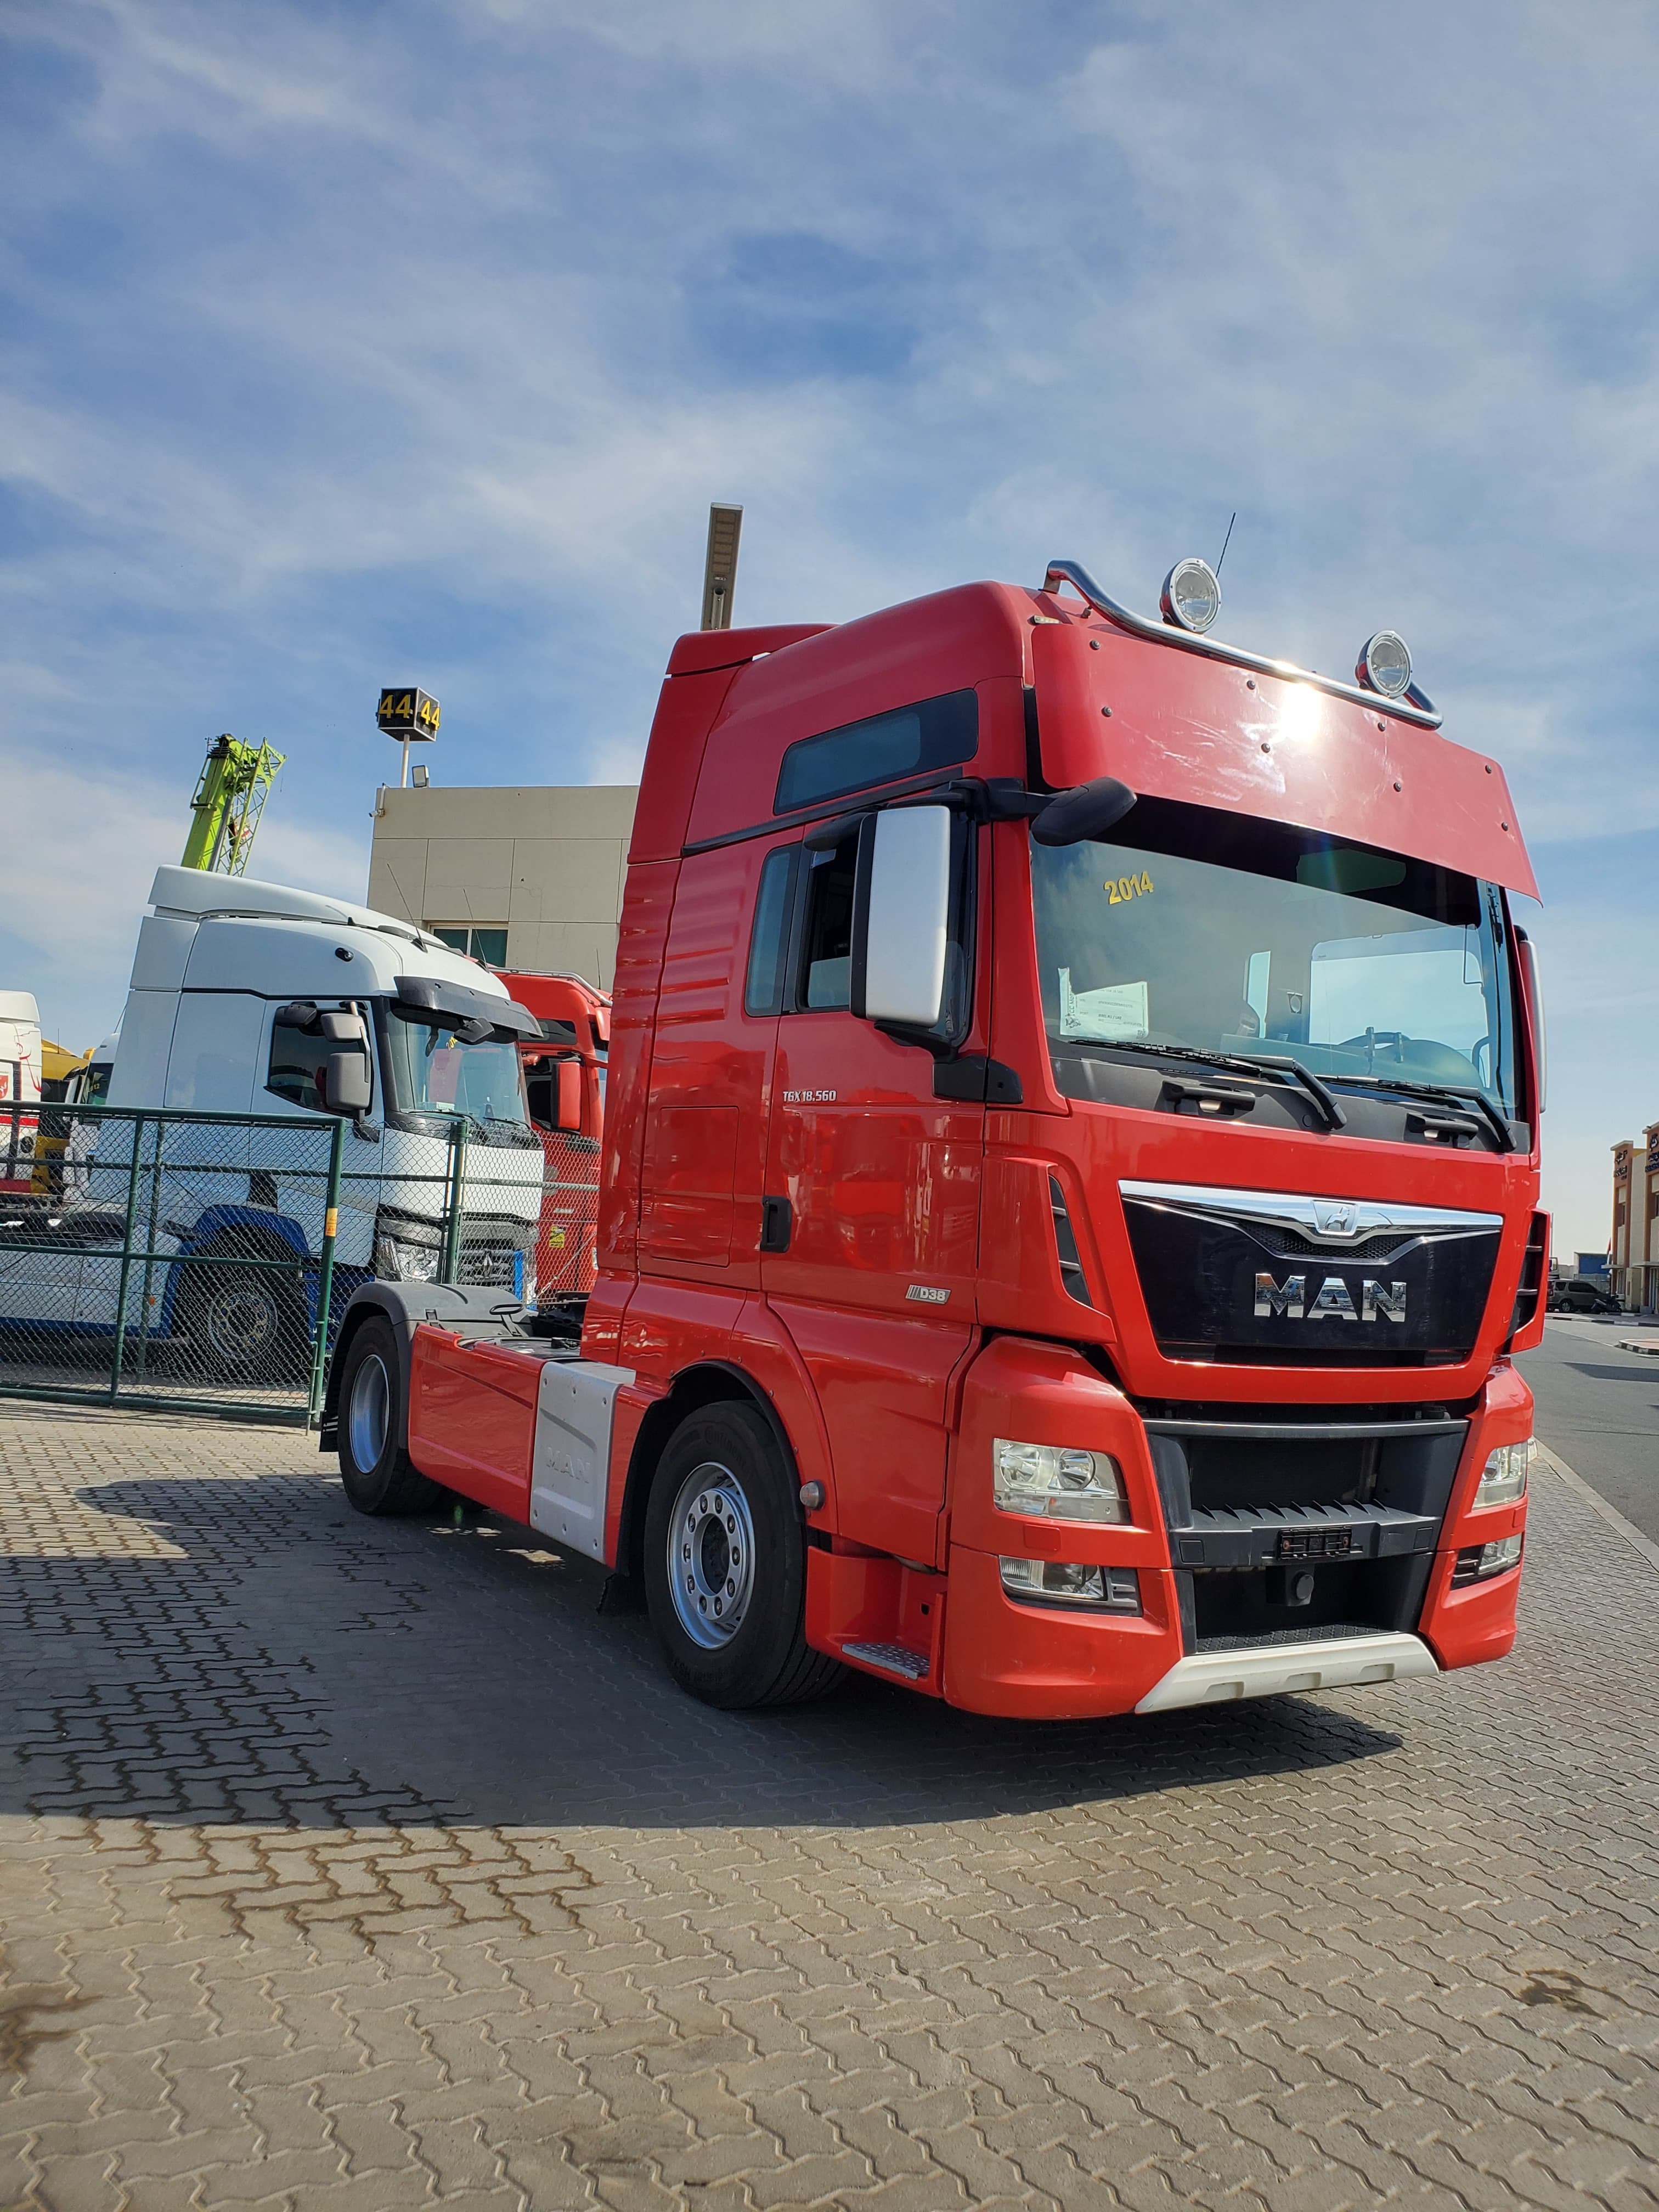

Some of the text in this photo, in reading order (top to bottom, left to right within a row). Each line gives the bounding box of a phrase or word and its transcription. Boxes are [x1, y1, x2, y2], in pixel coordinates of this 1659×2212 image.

[379, 694, 412, 719] 44
[421, 700, 441, 731] 44
[1104, 871, 1154, 905] 2014
[803, 1090, 837, 1102] 18.560
[920, 1288, 946, 1301] D38
[1254, 1273, 1407, 1322] MAN
[546, 1446, 591, 1485] MAN
